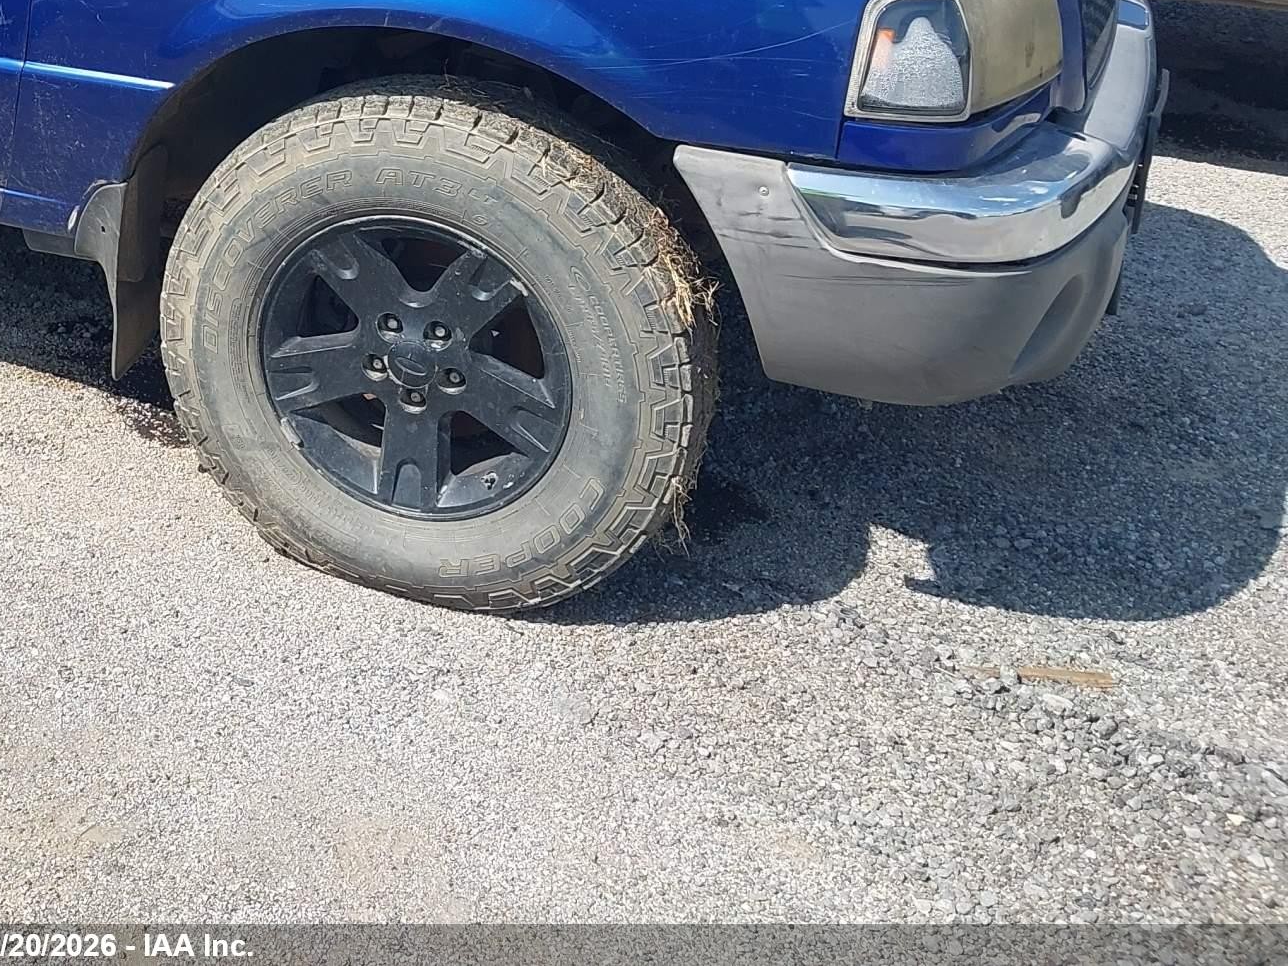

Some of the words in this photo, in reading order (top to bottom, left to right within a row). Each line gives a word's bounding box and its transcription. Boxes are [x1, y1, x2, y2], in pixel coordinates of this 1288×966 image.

[202, 169, 353, 354] DISCOVERER
[375, 168, 462, 197] AT3
[438, 477, 605, 578] COOPER
